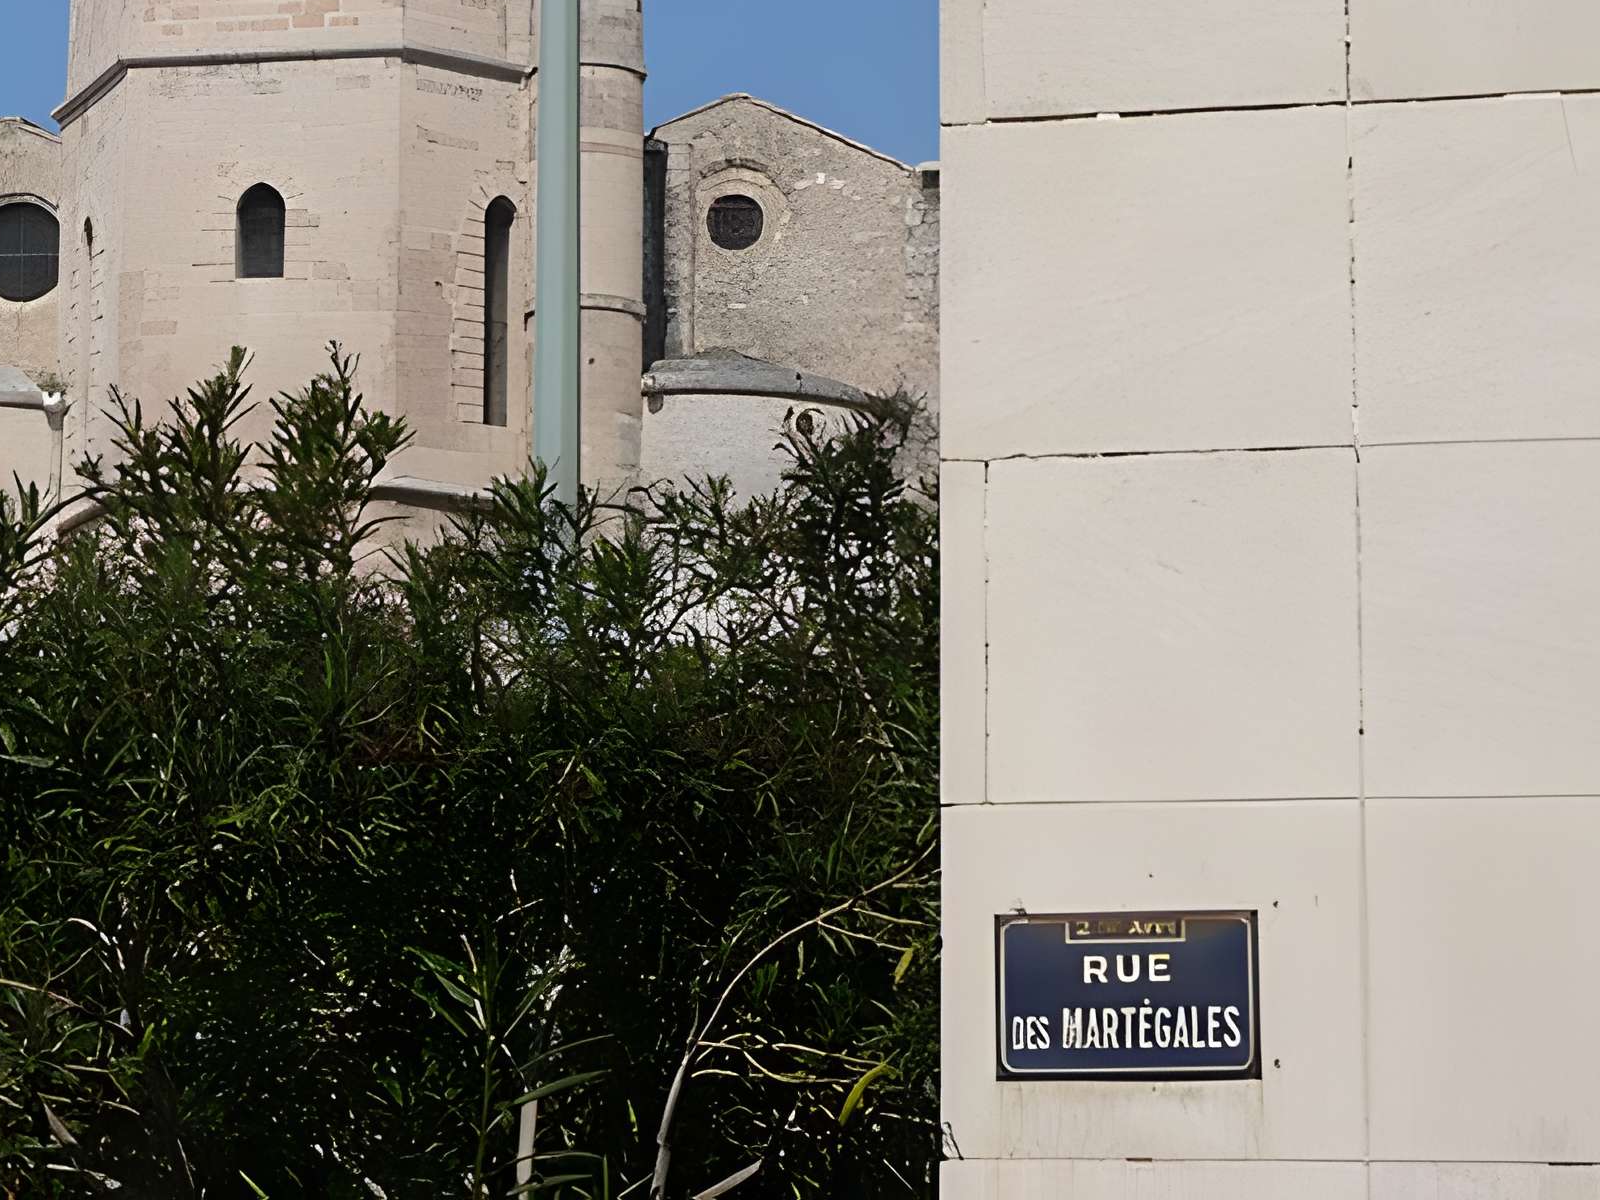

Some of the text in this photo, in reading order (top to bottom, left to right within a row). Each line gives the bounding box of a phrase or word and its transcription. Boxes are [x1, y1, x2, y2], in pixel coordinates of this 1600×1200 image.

[1083, 953, 1171, 983] RUE
[1012, 998, 1241, 1050] DES MARTÉGALES
